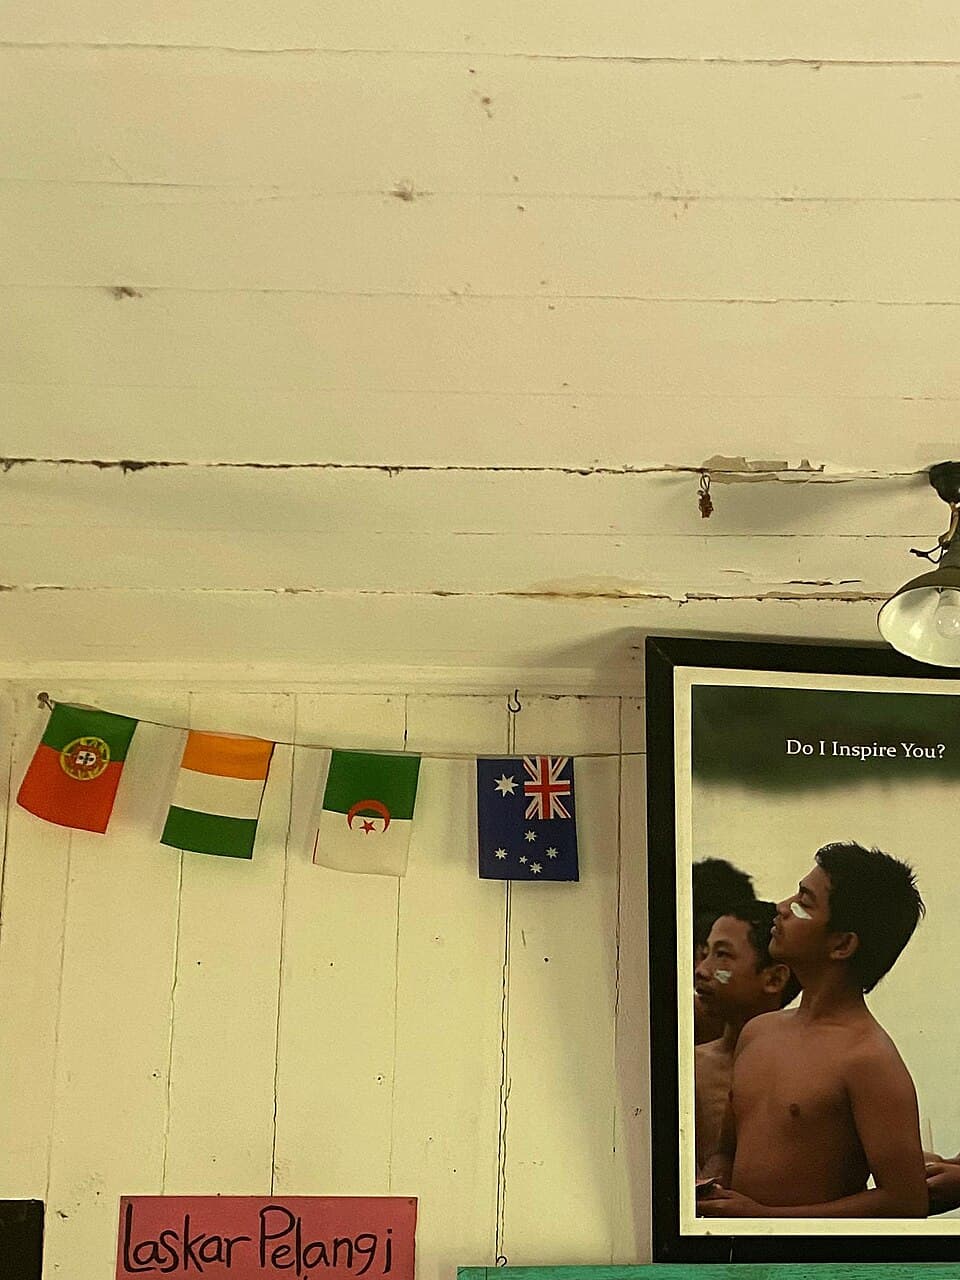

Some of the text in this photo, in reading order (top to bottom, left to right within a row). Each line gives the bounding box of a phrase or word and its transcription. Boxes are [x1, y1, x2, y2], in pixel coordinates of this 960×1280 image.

[786, 740, 945, 760] Do I Inspire You?
[123, 1203, 393, 1276] Laskar Pelangi
